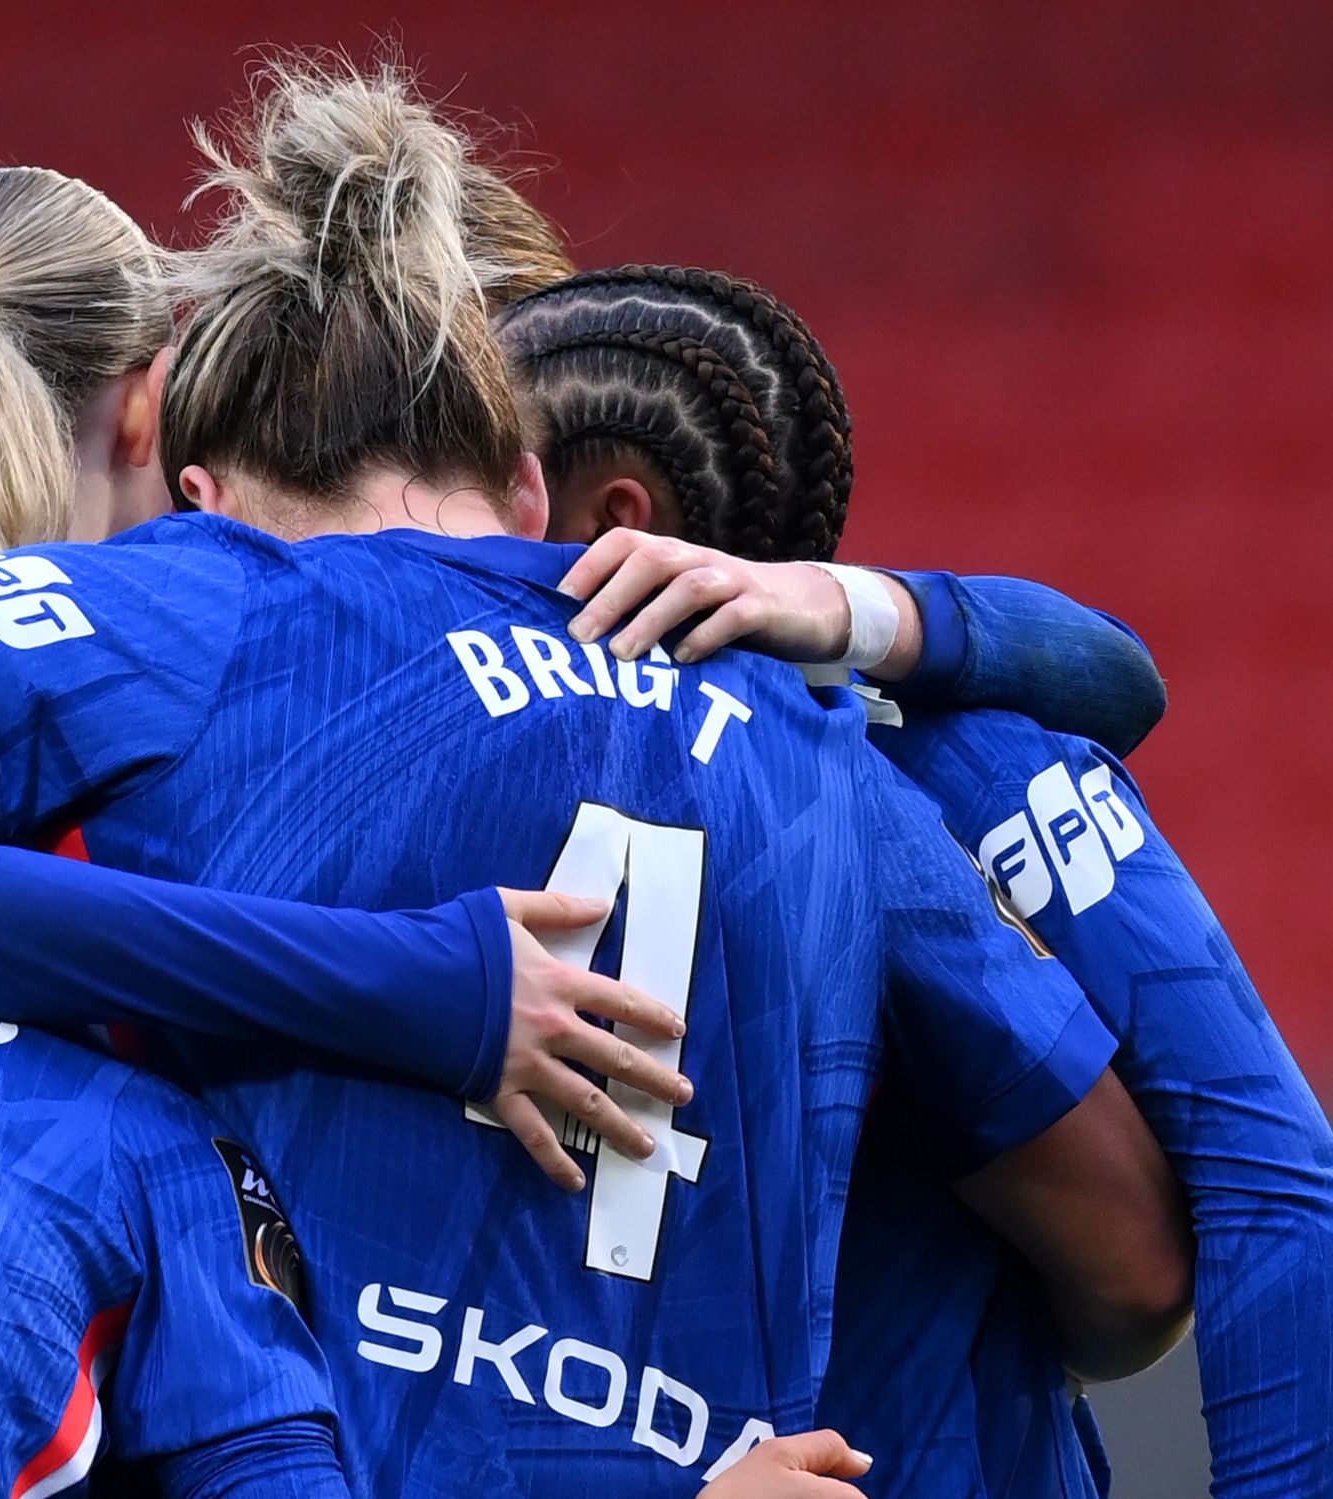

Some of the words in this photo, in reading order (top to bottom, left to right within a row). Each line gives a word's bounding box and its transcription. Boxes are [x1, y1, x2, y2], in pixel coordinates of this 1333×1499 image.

[447, 625, 753, 766] BRIGT
[991, 788, 1125, 901] FPT
[464, 801, 709, 1282] 4
